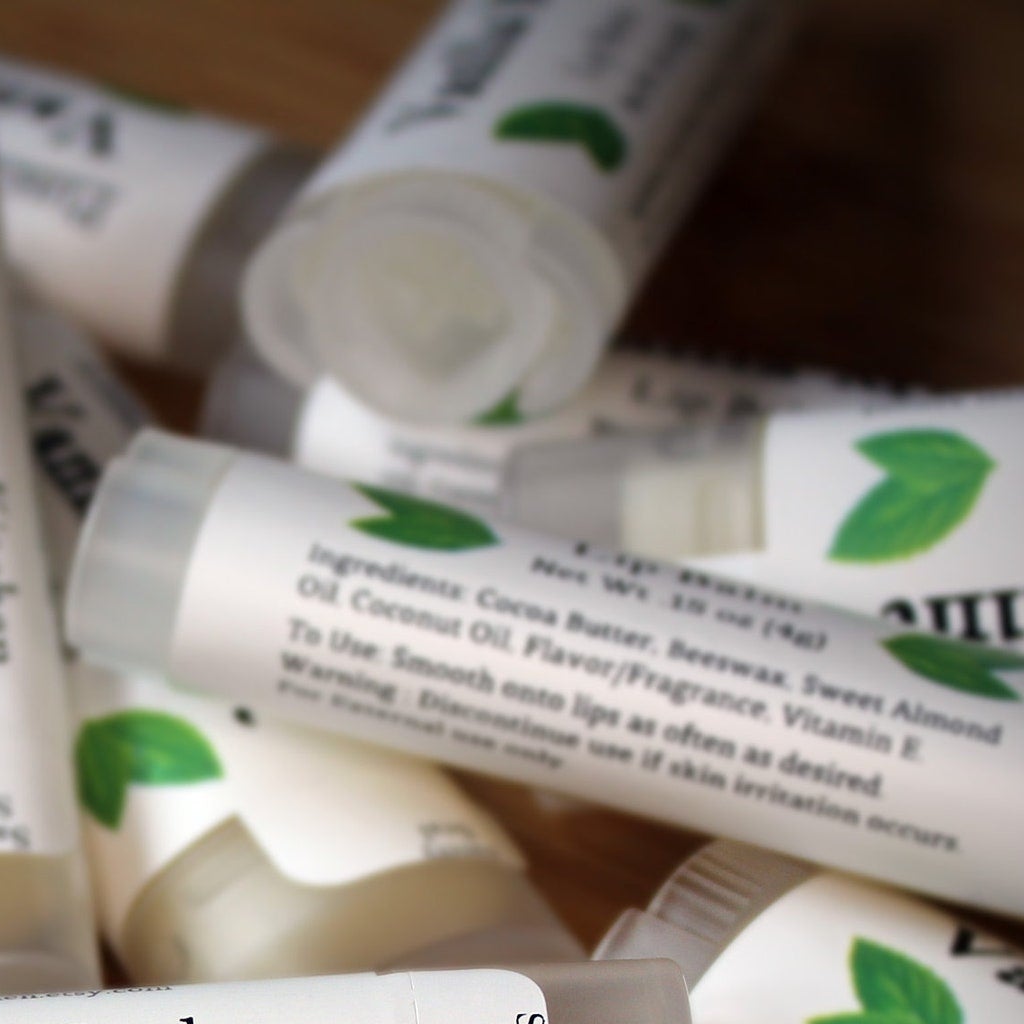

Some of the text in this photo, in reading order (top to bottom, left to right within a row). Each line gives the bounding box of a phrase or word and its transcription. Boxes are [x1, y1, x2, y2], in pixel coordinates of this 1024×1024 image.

[280, 650, 397, 704] Warning
[417, 688, 580, 750] Discontinue
[587, 737, 633, 764] use
[669, 754, 728, 792] skin
[733, 770, 862, 828] irritation
[288, 616, 323, 647] To
[391, 646, 496, 696] Smooth
[500, 676, 567, 712] onto
[570, 691, 621, 729] lips
[625, 712, 658, 737] as
[662, 721, 737, 760] often
[743, 743, 773, 768] as
[350, 589, 463, 638] Coconut
[781, 702, 893, 756] Vitamin
[476, 587, 558, 626] Cocoa
[802, 674, 885, 717] Sweet
[892, 700, 1004, 747] Almond
